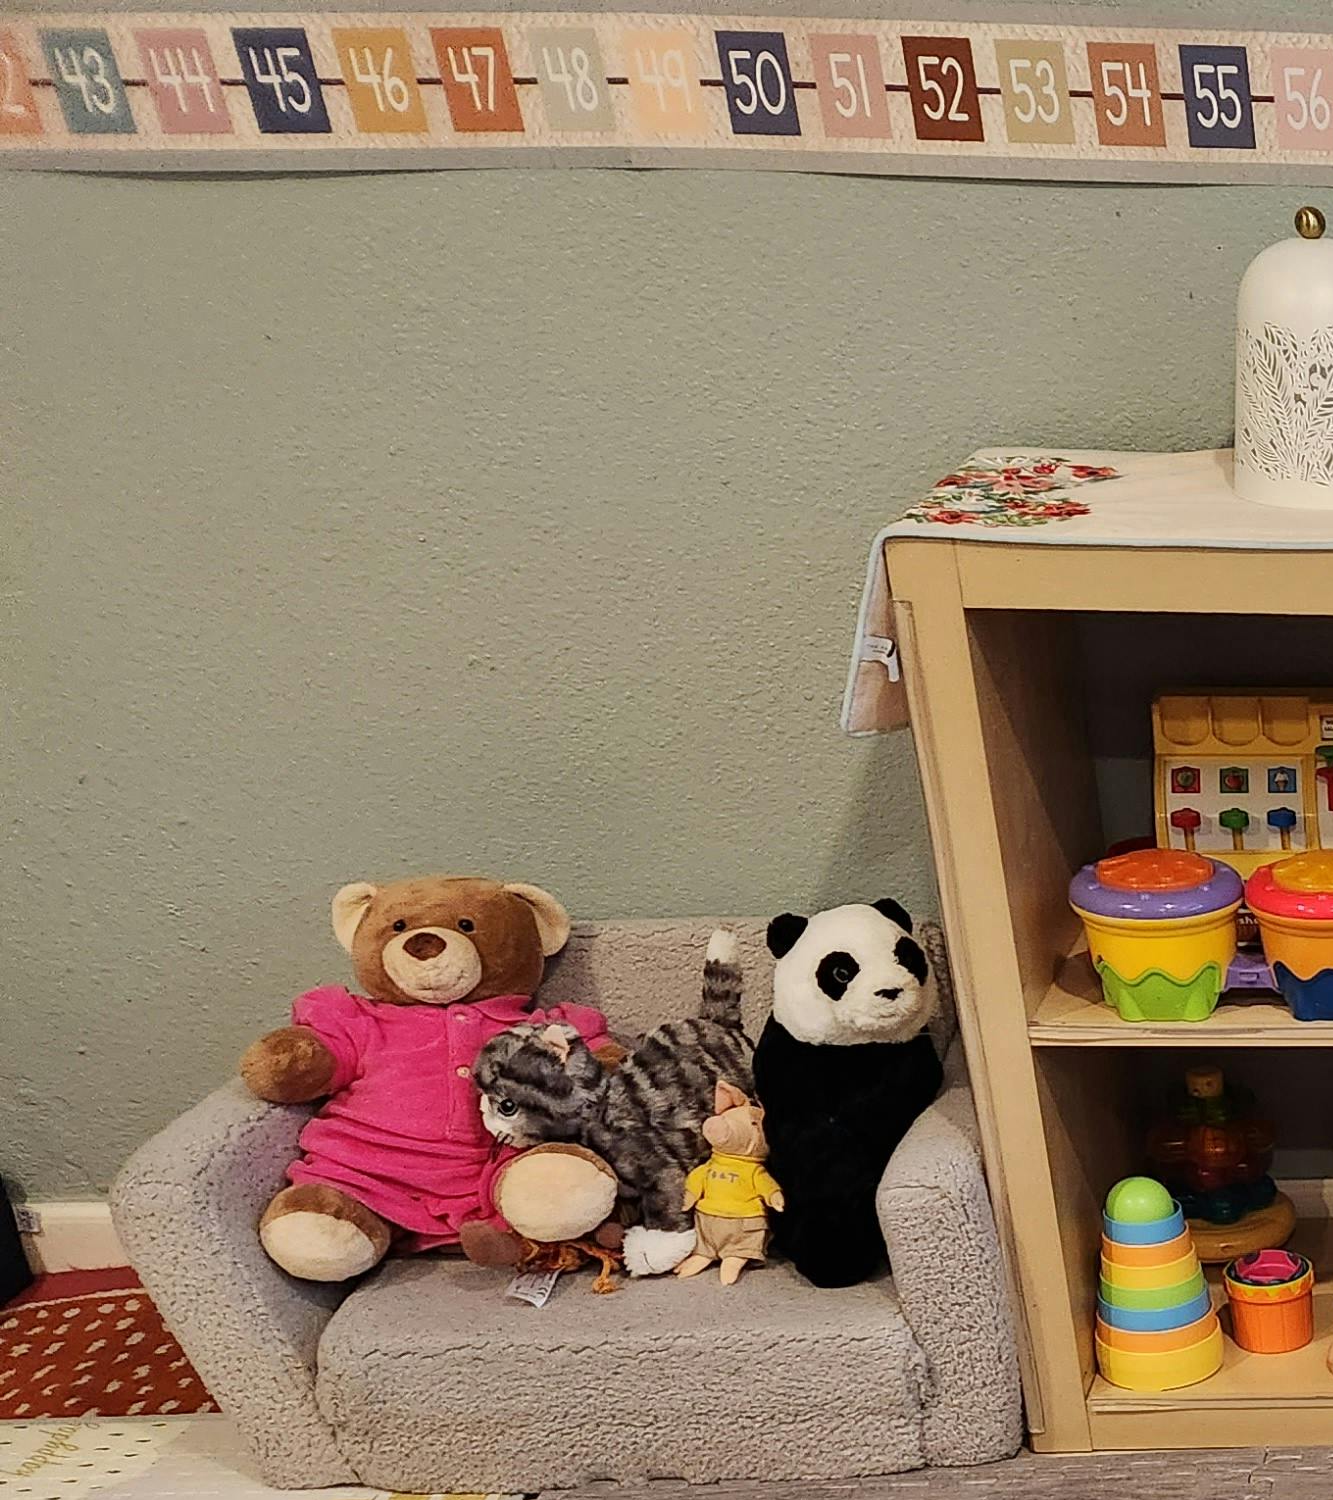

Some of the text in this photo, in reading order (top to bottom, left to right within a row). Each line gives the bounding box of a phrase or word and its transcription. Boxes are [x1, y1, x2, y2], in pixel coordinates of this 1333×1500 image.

[53, 46, 116, 114] 43
[149, 47, 215, 113] 44
[248, 47, 312, 113] 45
[348, 47, 409, 112] 46
[446, 46, 498, 111] 47
[537, 47, 598, 111] 48
[635, 49, 693, 113] 49
[727, 50, 787, 116] 50
[828, 53, 872, 119] 51
[917, 56, 970, 122] 52
[1008, 59, 1060, 124] 53
[1101, 61, 1151, 127] 54
[1193, 64, 1242, 129] 55
[1284, 68, 1331, 131] 56
